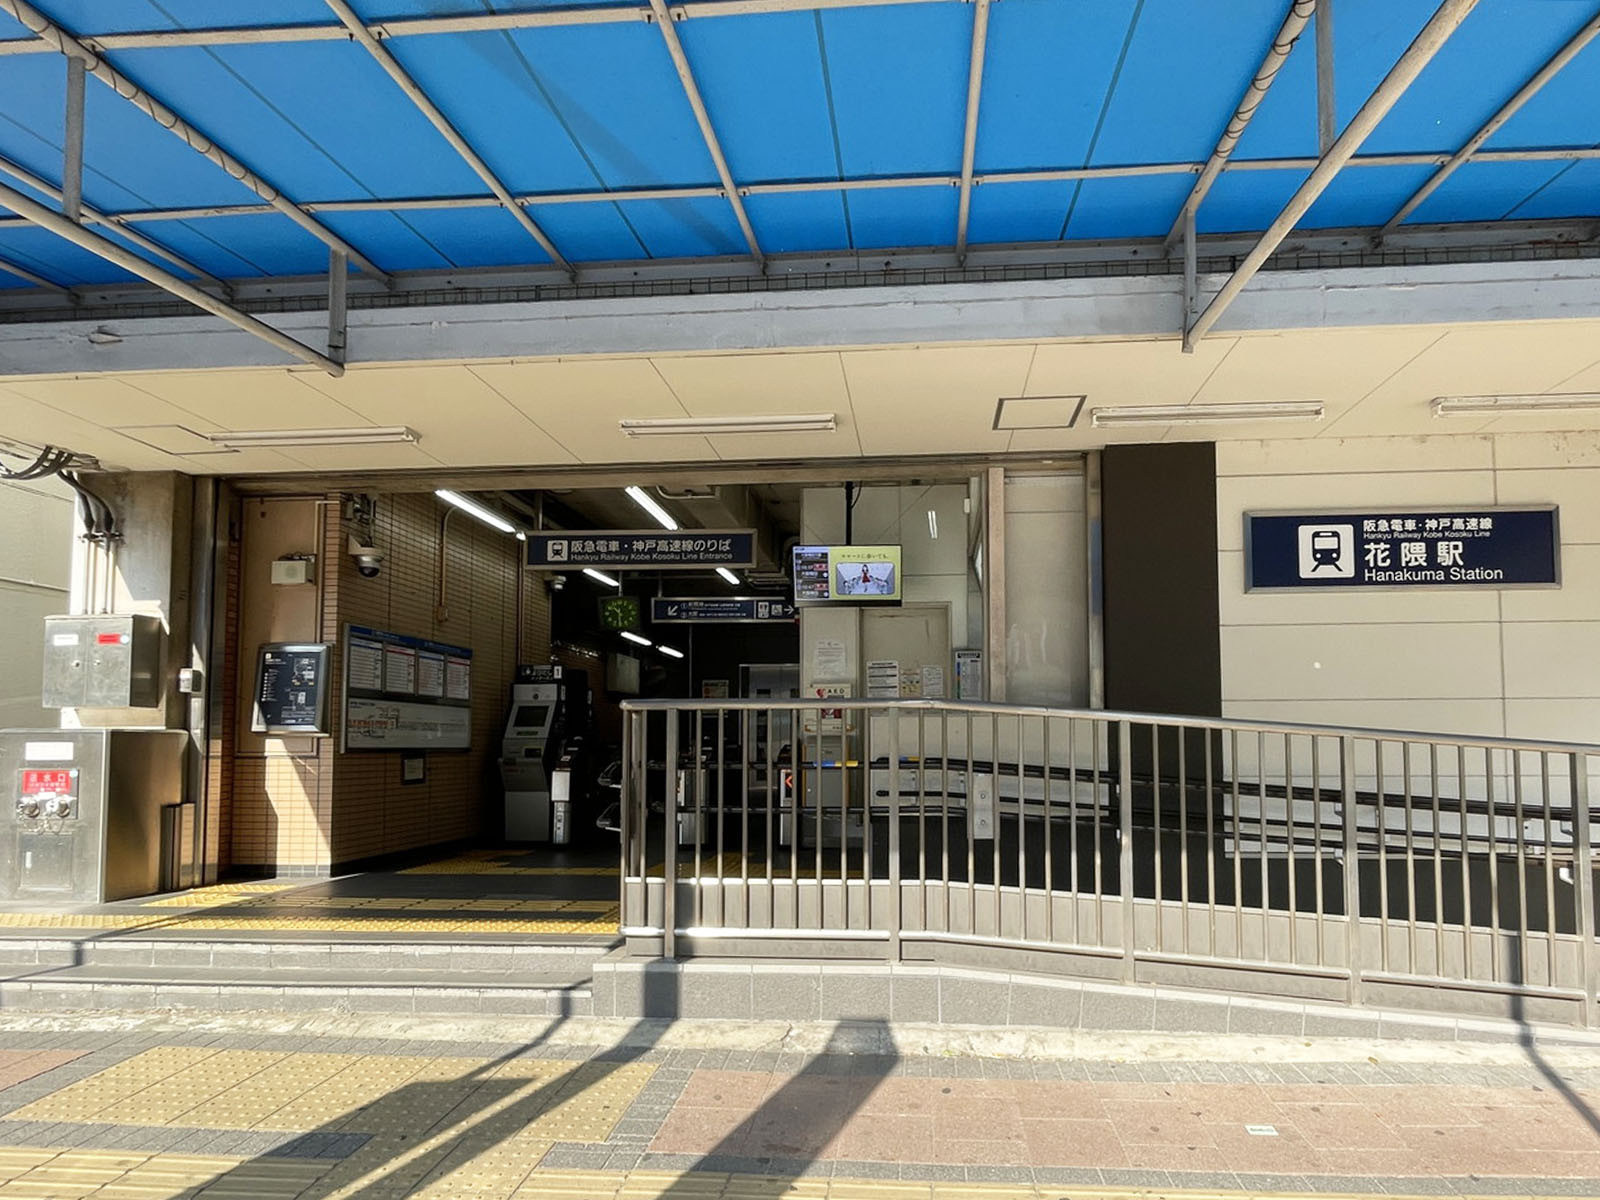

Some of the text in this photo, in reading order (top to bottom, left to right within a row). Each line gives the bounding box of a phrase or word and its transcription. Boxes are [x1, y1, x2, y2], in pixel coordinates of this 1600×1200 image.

[1363, 517, 1493, 531] 阪急電車・神戸高速線
[1363, 531, 1392, 540] Hankyu
[1393, 531, 1422, 540] Railway
[1423, 530, 1443, 538] Kobe
[1444, 530, 1473, 538] Kosoku
[570, 539, 731, 552] 阪急電車・神戸高速線のりば
[570, 552, 733, 561] Hankyu Railway Kobe Kosoku Line Entrance
[1363, 541, 1464, 567] 花隈駅
[1364, 566, 1504, 582] Hanakuma Station
